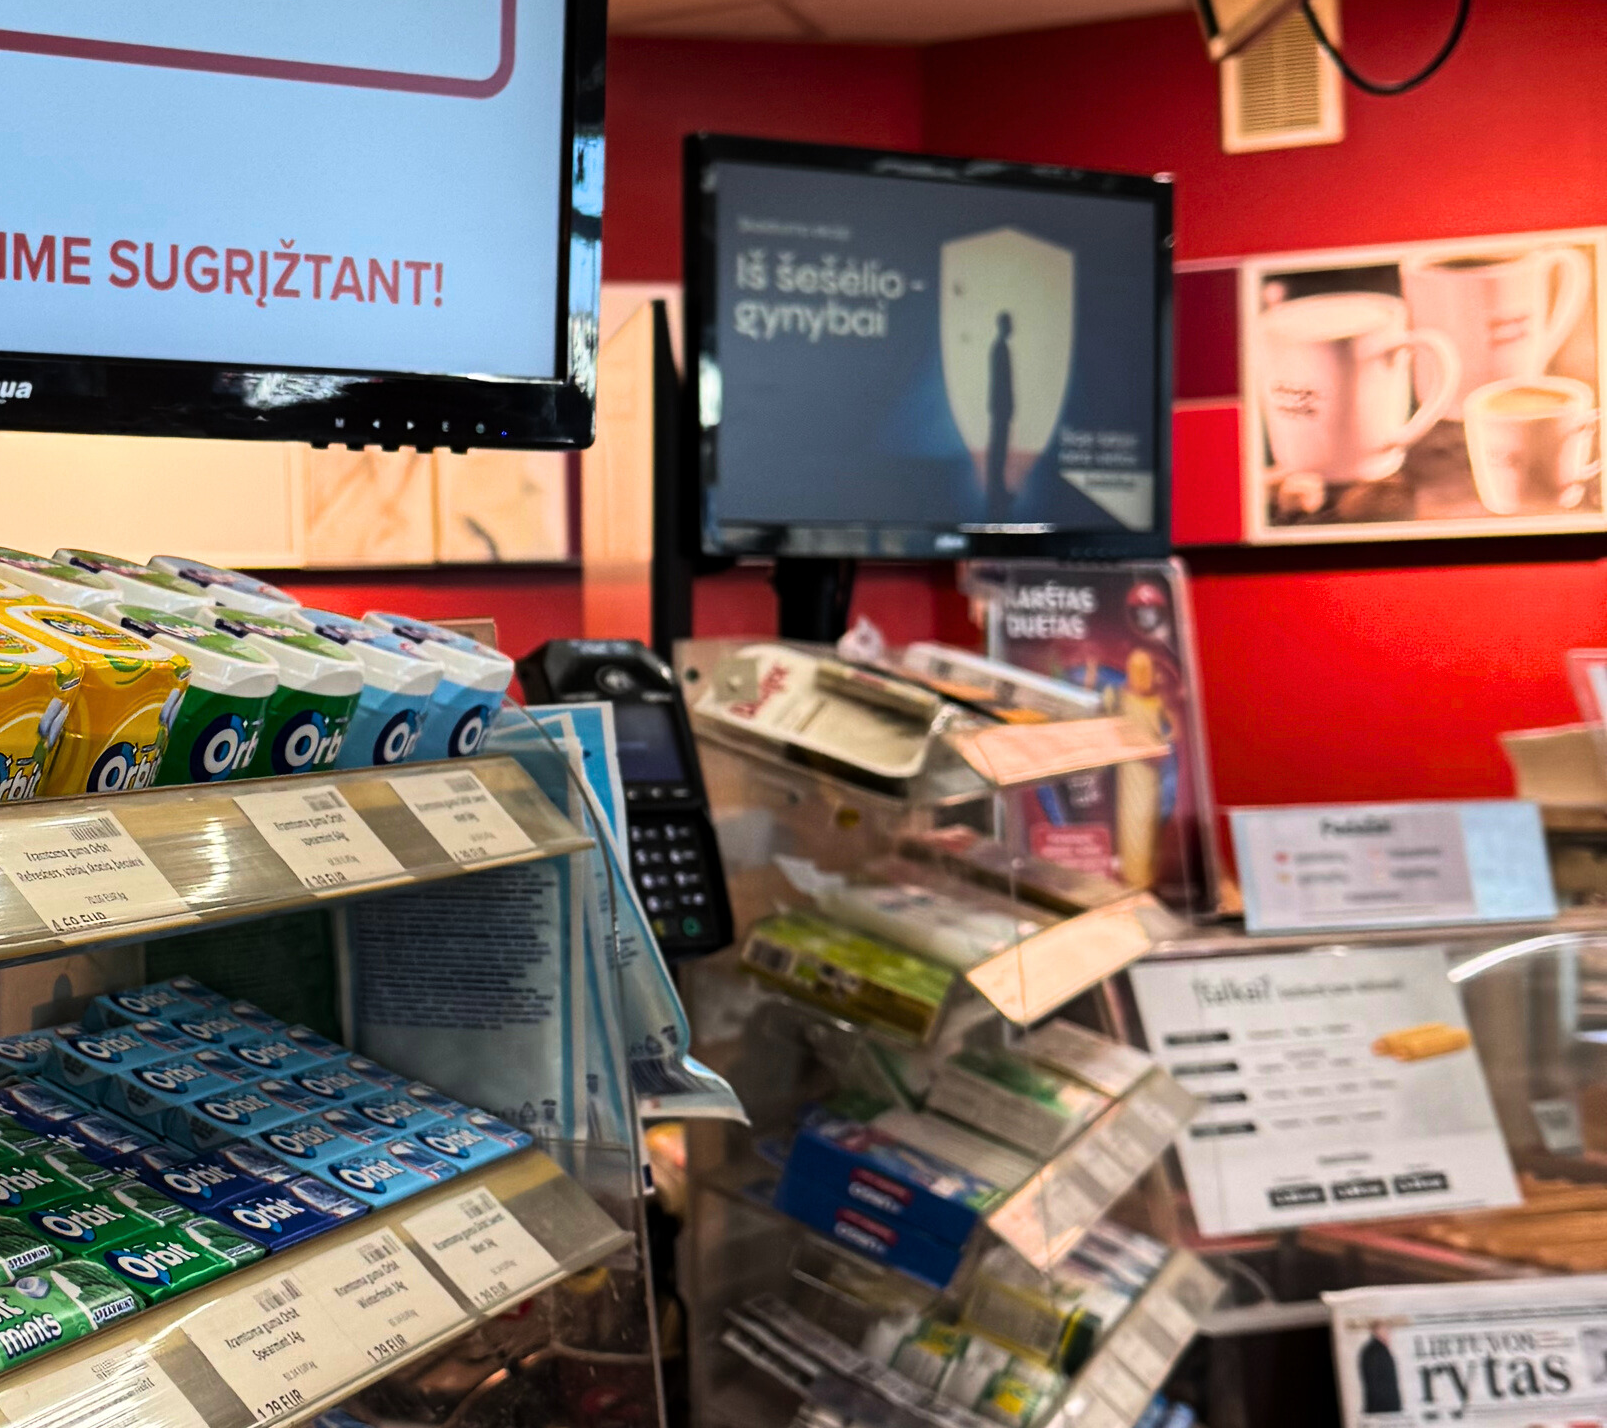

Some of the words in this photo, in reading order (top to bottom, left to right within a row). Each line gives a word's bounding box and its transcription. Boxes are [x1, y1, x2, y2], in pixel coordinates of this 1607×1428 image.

[107, 238, 446, 308] SUGRĮŽTANT!
[777, 251, 905, 300] šešėlio
[734, 298, 888, 342] gynybai
[1417, 1348, 1574, 1410] rytas
